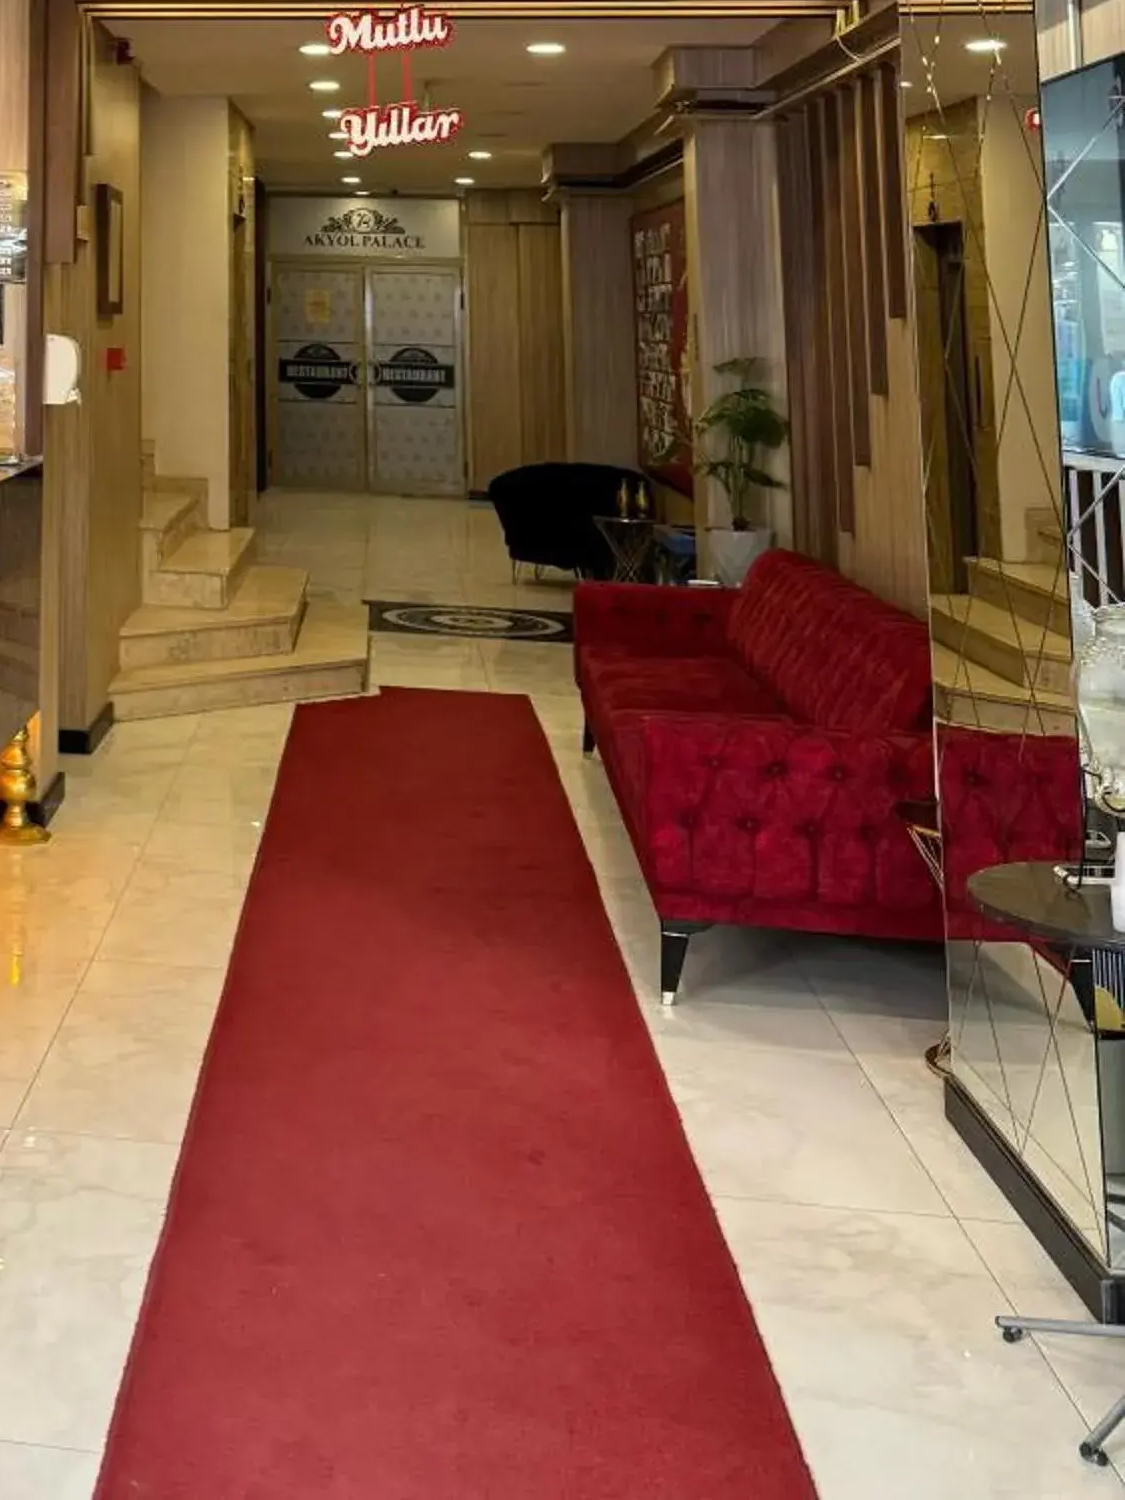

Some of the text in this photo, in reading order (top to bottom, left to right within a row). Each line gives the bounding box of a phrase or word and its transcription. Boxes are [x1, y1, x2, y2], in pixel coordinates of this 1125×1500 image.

[328, 6, 449, 55] Mutlu
[305, 233, 426, 249] AKYOL PALACE
